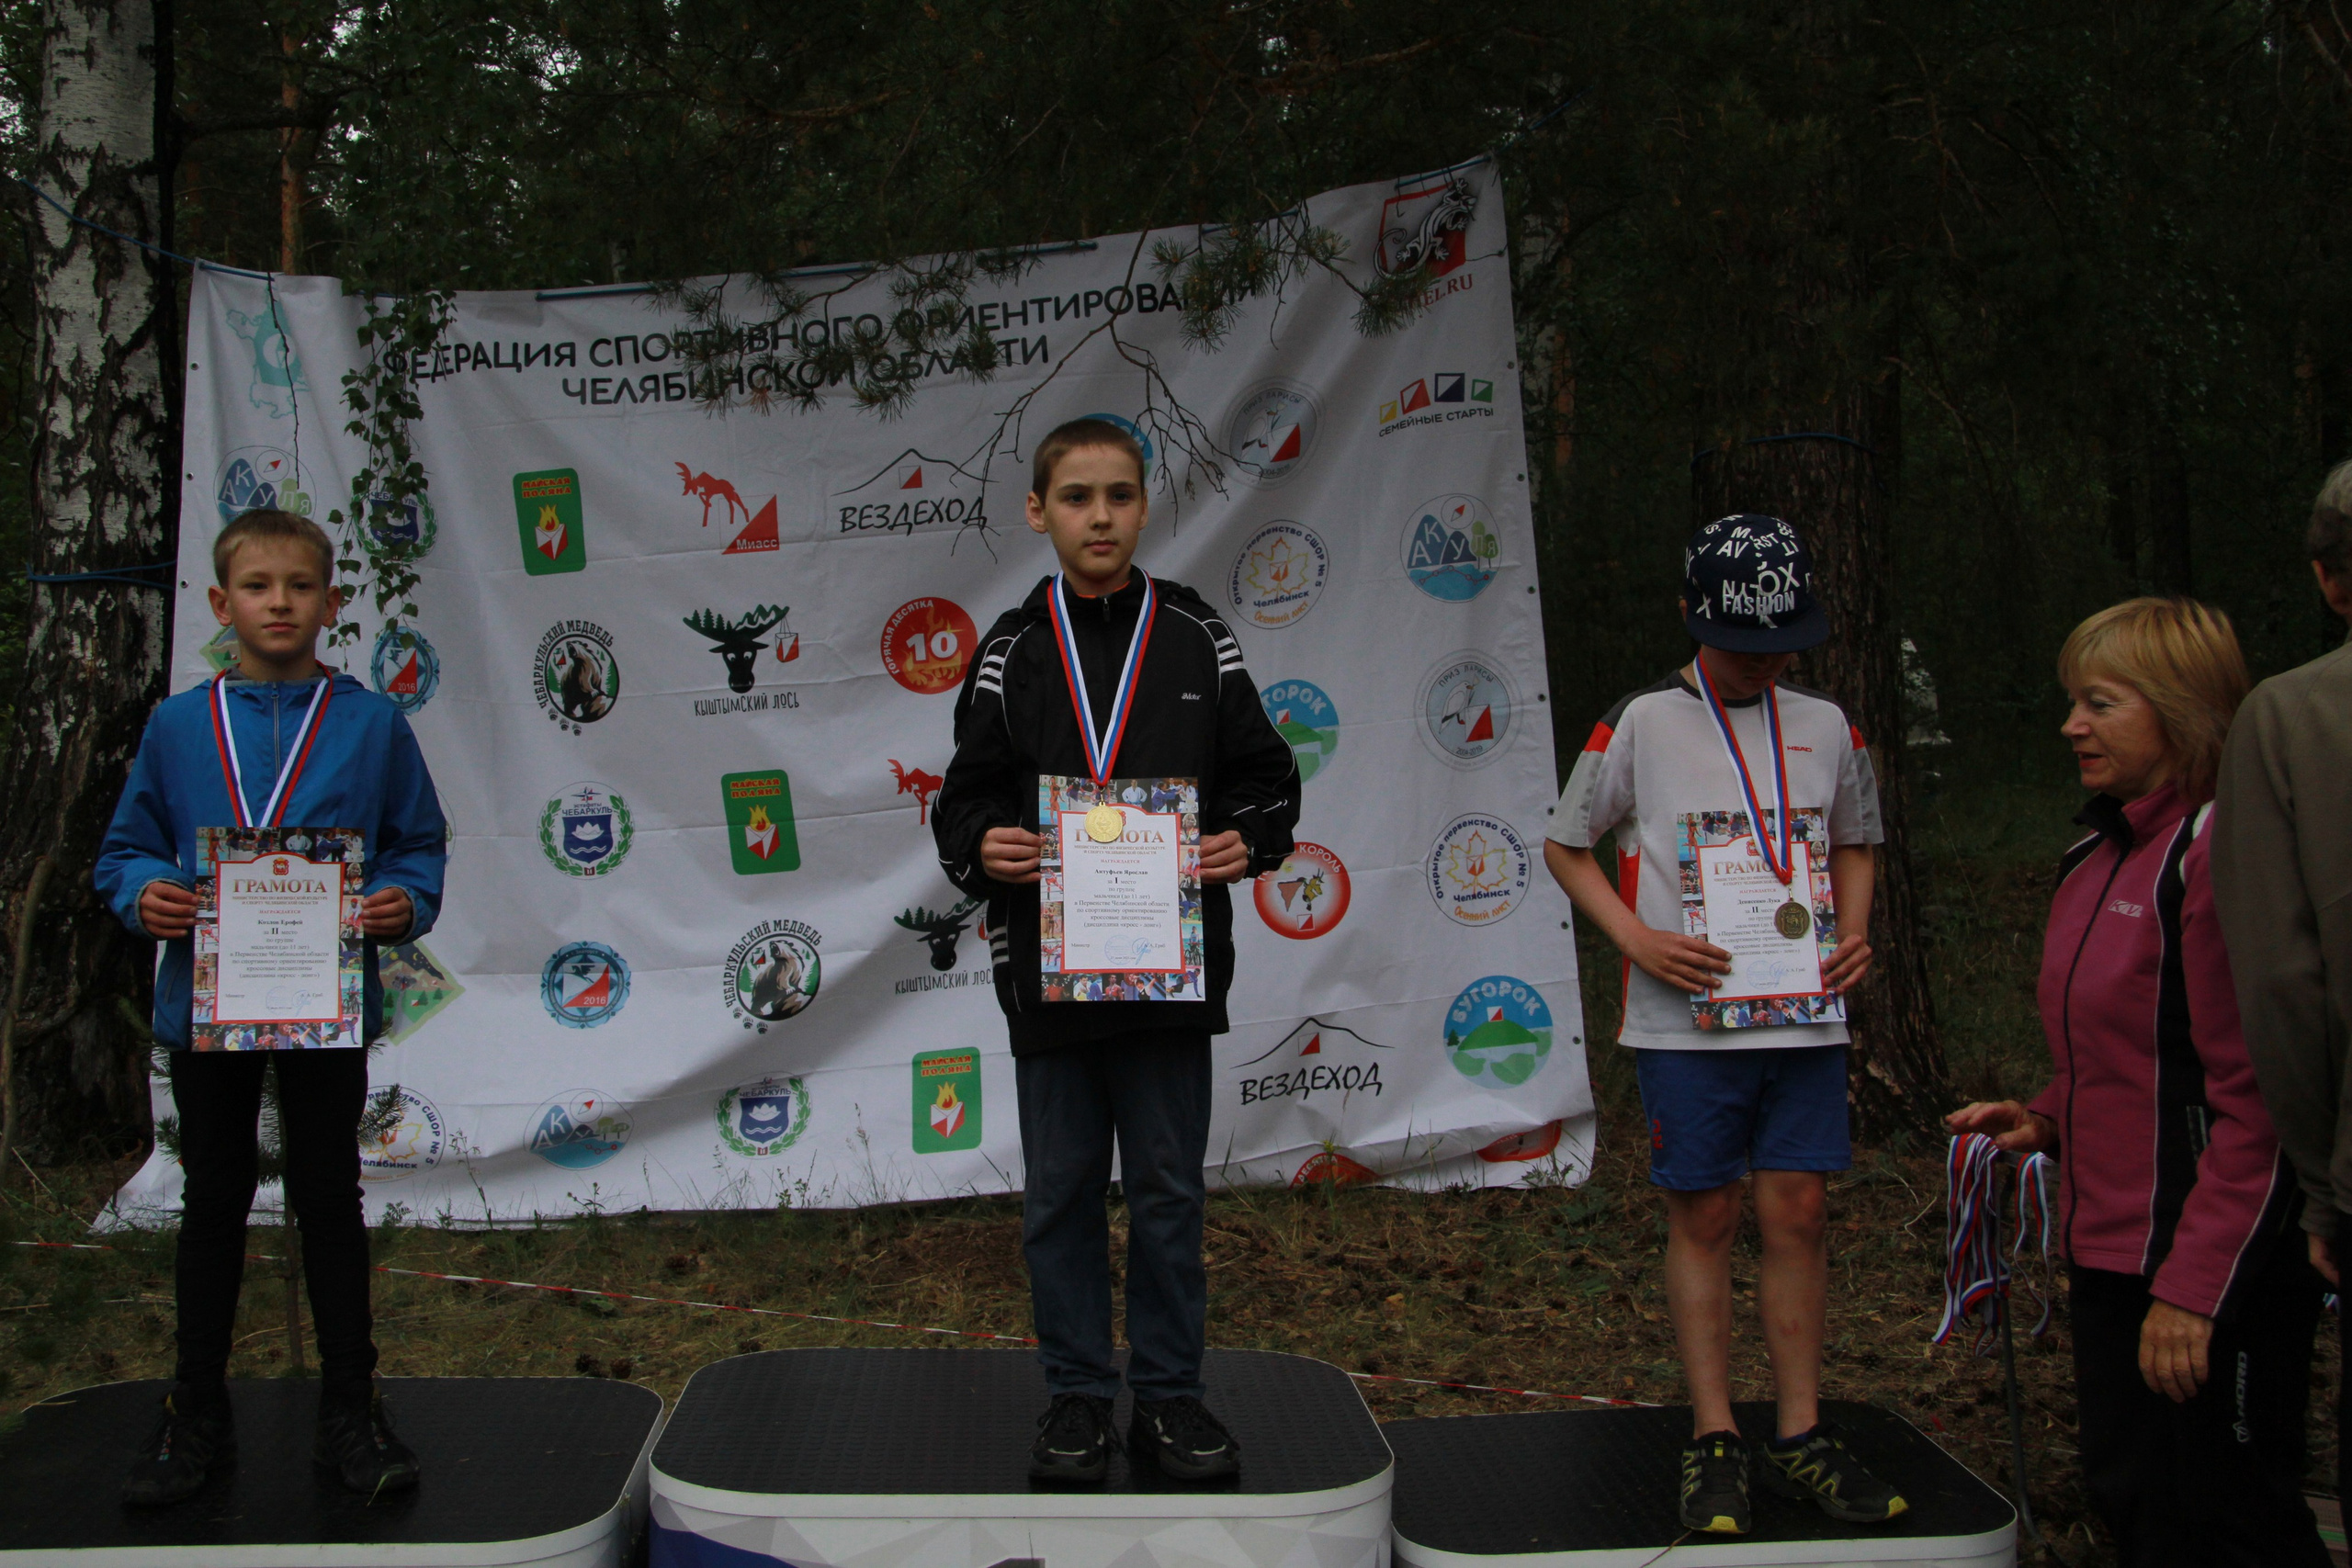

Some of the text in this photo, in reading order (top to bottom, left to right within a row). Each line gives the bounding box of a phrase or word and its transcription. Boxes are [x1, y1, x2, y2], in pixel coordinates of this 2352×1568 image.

[869, 334, 1049, 382] ОБЛАТИ
[1379, 407, 1494, 437] СЕМЕЙНЫЕ СТАРТЫ
[522, 476, 571, 490] МАЙСКАЯ
[522, 487, 571, 499] ПОЛЯНА
[840, 497, 988, 536] ВЕЗДЕХОД
[736, 538, 778, 550] Миасс
[1253, 591, 1309, 607] Челябинск
[1723, 591, 1795, 616] FASHION
[883, 599, 934, 674] ГОРЯЧАЯ ДЕСЯТКА
[906, 630, 957, 661] 10
[534, 620, 614, 708] ЧЕБАРКУЛЬСКИЙ МЕДВЕДЬ
[1438, 665, 1495, 687] ПРИЗ ЛАРИСЫ
[398, 682, 416, 692] 2016
[694, 692, 800, 716] КЫШТЫМСКИЙ ЛОСЬ
[730, 777, 780, 789] МАЙСКАЯ
[731, 787, 781, 798] ПОЛЯНА
[562, 807, 613, 816] ЧЕБАРКУЛЬ
[1299, 844, 1341, 873] КОРОЛЬ
[1432, 843, 1444, 899] Открытое
[1443, 819, 1498, 842] первенство
[1500, 828, 1524, 859] СШОР
[232, 879, 327, 893] ГРАМОТА
[1453, 889, 1510, 902] Челябинск
[1454, 899, 1510, 920] Осенний лист
[723, 919, 822, 1008] ЧЕБАРКУЛЬСКИЙ МЕДВЕДЬ
[895, 968, 996, 995] КЫШТЫМСКИЙ ЛОС
[583, 996, 606, 1005] 2016
[1452, 980, 1541, 1023] БУГОРОК
[921, 1065, 972, 1077] ПОЛЯНА
[922, 1055, 972, 1067] МАЙСКАЯ
[740, 1088, 791, 1098] ЧЕБАРКУЛЬ
[1239, 1062, 1383, 1105] ВЕЗДЕХОД
[422, 1105, 440, 1137] СШОР
[361, 1157, 417, 1169] елябинск
